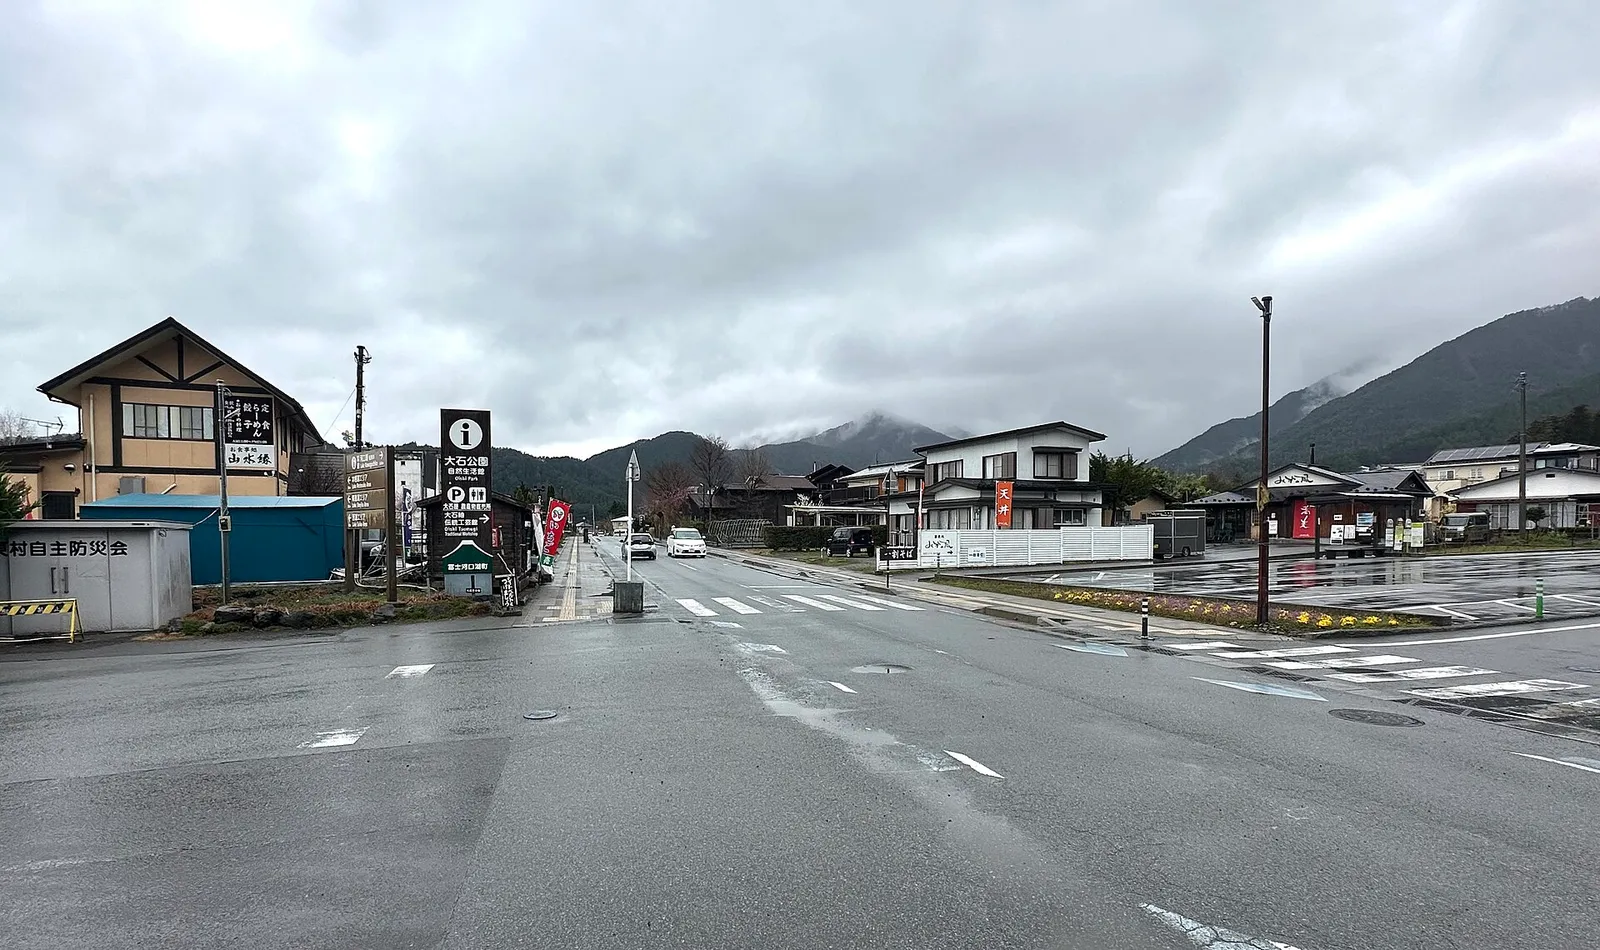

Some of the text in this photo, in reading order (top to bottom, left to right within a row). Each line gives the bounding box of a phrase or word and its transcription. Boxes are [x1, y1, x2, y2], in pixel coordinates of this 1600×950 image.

[243, 403, 253, 429] 餃子
[252, 403, 262, 437] らーめん
[261, 403, 271, 430] 定食
[444, 455, 489, 467] 大石公園
[447, 467, 485, 475] 自然生活館
[447, 563, 489, 571] 富士河口湖町
